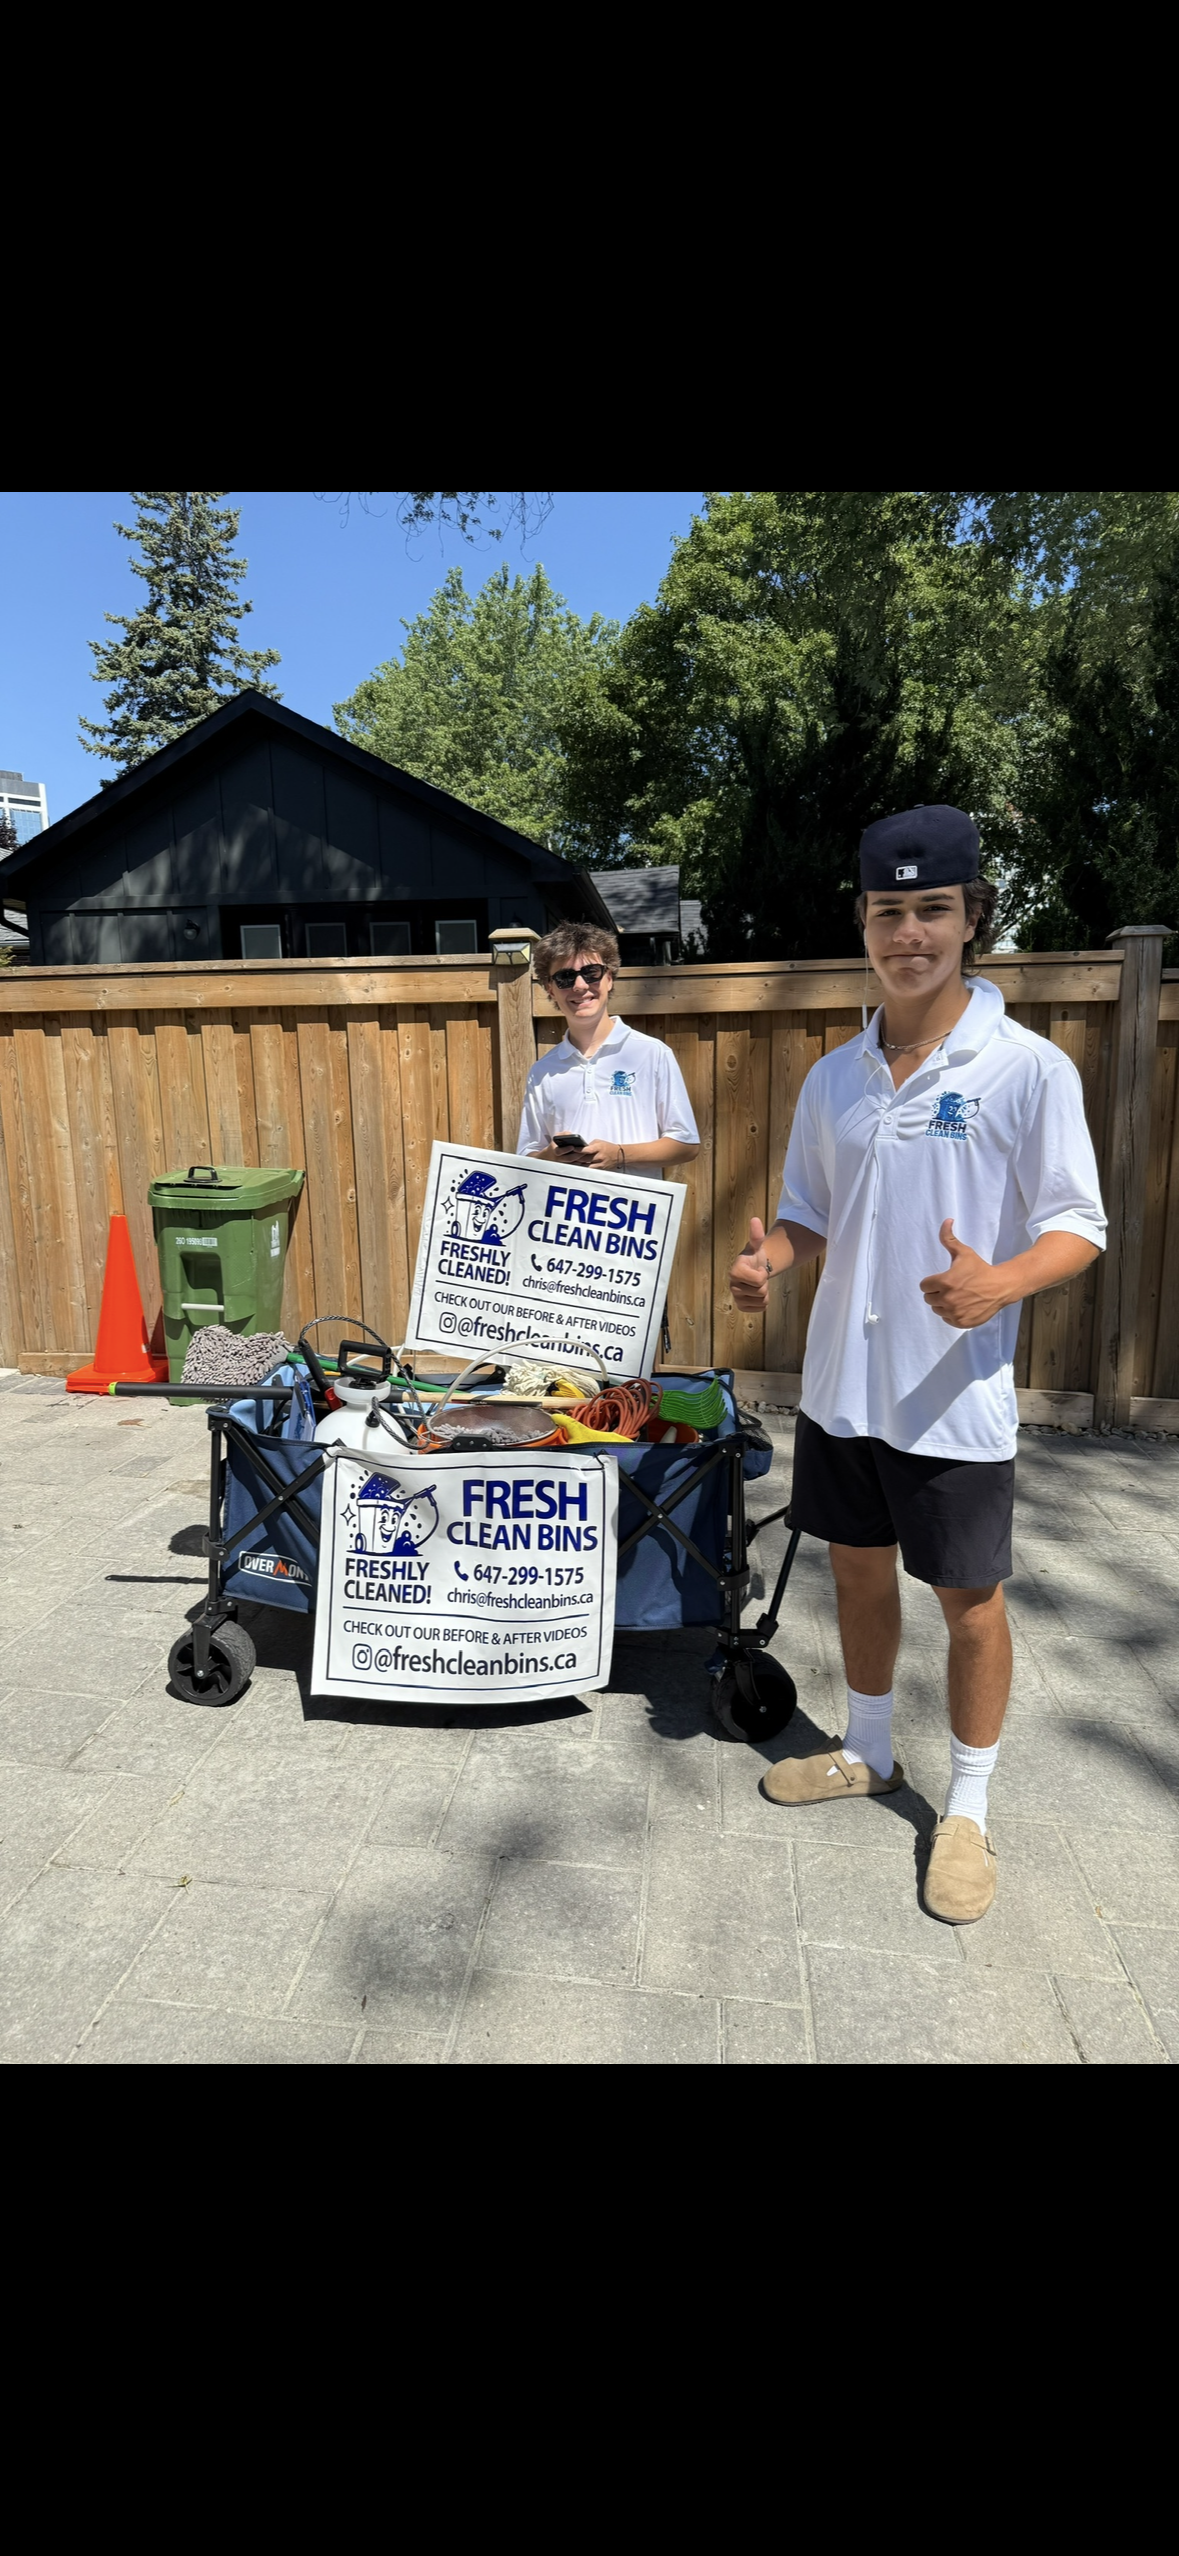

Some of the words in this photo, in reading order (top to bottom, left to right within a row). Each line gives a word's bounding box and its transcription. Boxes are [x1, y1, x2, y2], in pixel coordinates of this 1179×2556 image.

[925, 1129, 948, 1138] CLEAN
[950, 1131, 968, 1140] BINS
[928, 1120, 967, 1133] FRESH
[544, 1185, 657, 1235] FRESH
[440, 1240, 511, 1267] FRESHLY
[527, 1220, 602, 1251] CLEAN
[605, 1232, 659, 1261] BINS
[437, 1259, 511, 1286] CLEANED!
[546, 1257, 642, 1287] 647-299-1575
[522, 1275, 646, 1307] chris@freshcleanbins.ca
[434, 1291, 468, 1307] CHECK
[469, 1298, 492, 1312] OUT
[492, 1302, 515, 1316] OUR
[516, 1307, 555, 1324] BEFORE
[556, 1314, 564, 1325] &
[565, 1315, 599, 1330] AFTER
[599, 1320, 637, 1337] VIDEOS
[462, 1479, 588, 1521] FRESH
[447, 1521, 531, 1550] CLEAN
[538, 1525, 598, 1552] BINS
[345, 1558, 430, 1580] FRESHLY
[473, 1563, 585, 1586] 647-299-1575
[344, 1579, 431, 1604] CLEANED!
[447, 1587, 594, 1610] chris@freshcleanbins.ca
[343, 1619, 383, 1637] CHECK
[384, 1624, 411, 1639] OUT
[413, 1626, 441, 1641] OUR
[443, 1627, 489, 1644] BEFORE
[491, 1630, 501, 1645] &
[503, 1630, 542, 1645] AFTER
[543, 1625, 588, 1643] VIDEOS
[374, 1645, 577, 1676] @freshcleanbins.ca
